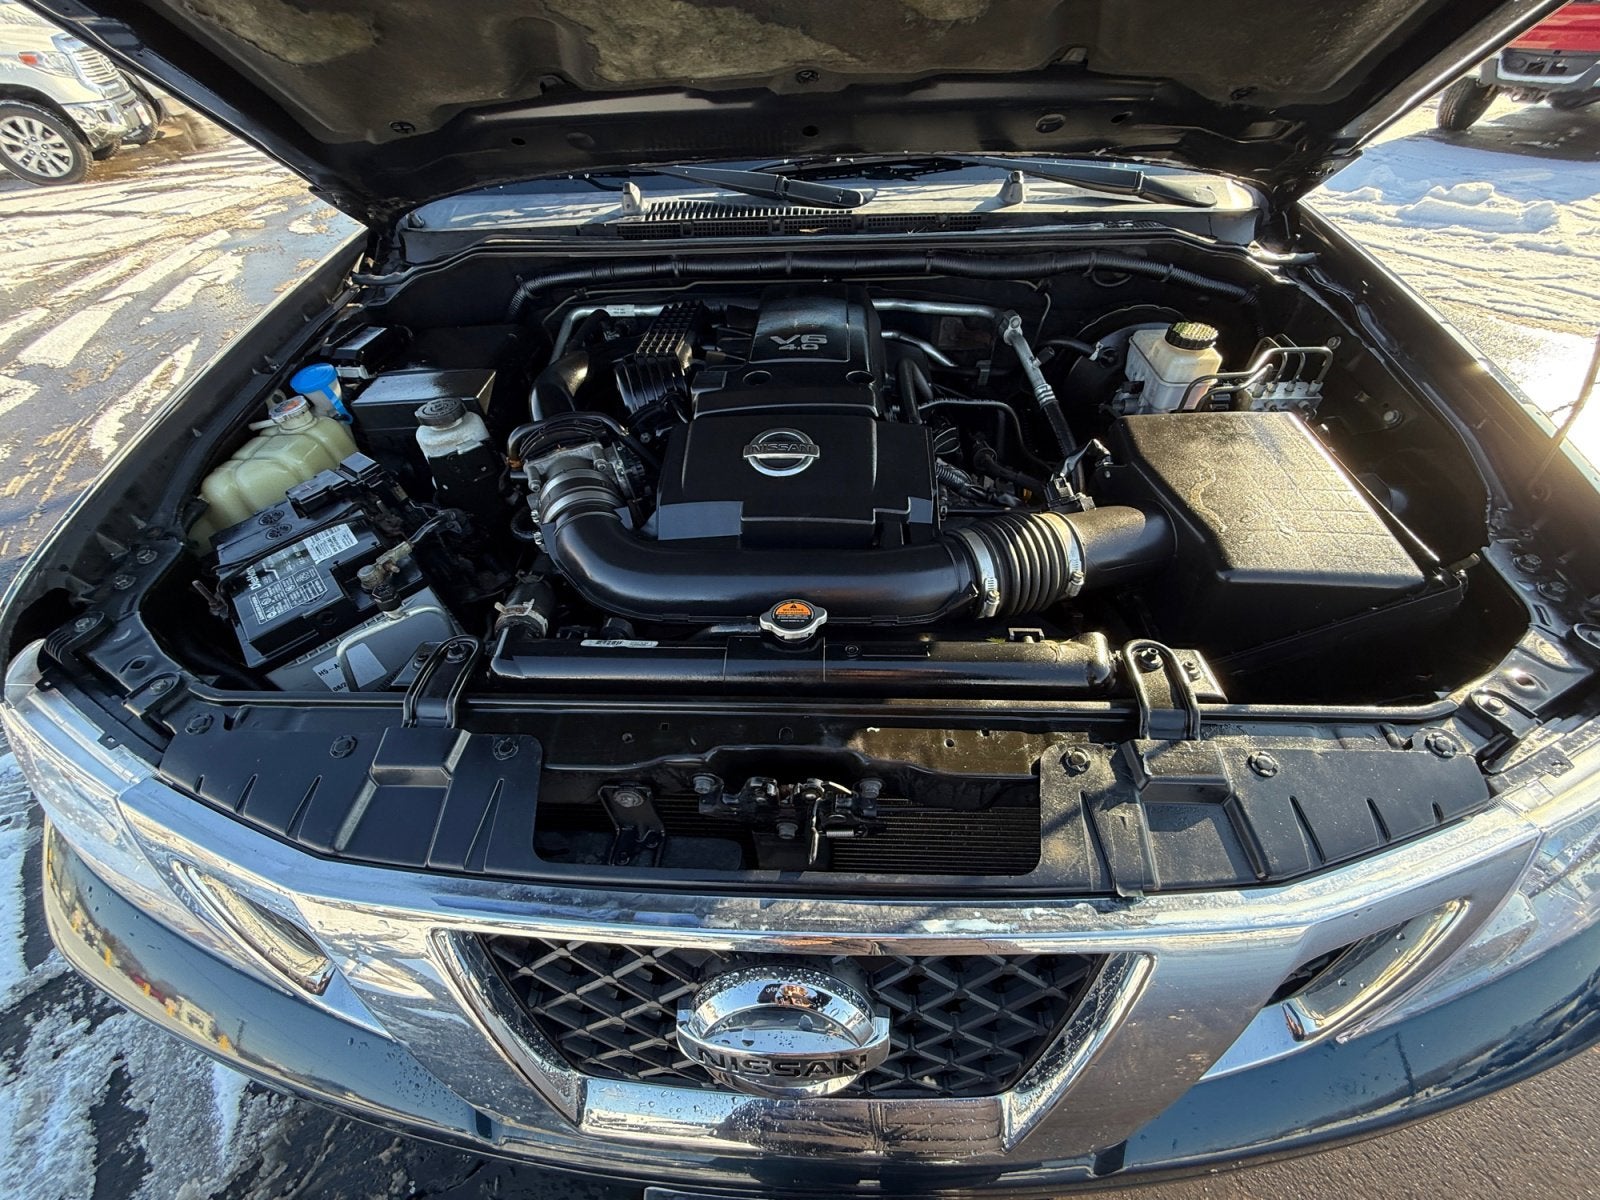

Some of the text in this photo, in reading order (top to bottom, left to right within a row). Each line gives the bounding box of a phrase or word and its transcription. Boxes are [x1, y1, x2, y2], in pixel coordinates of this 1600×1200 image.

[770, 334, 828, 345] V6
[750, 443, 813, 453] NISSAN
[699, 1048, 869, 1078] NISSAN
